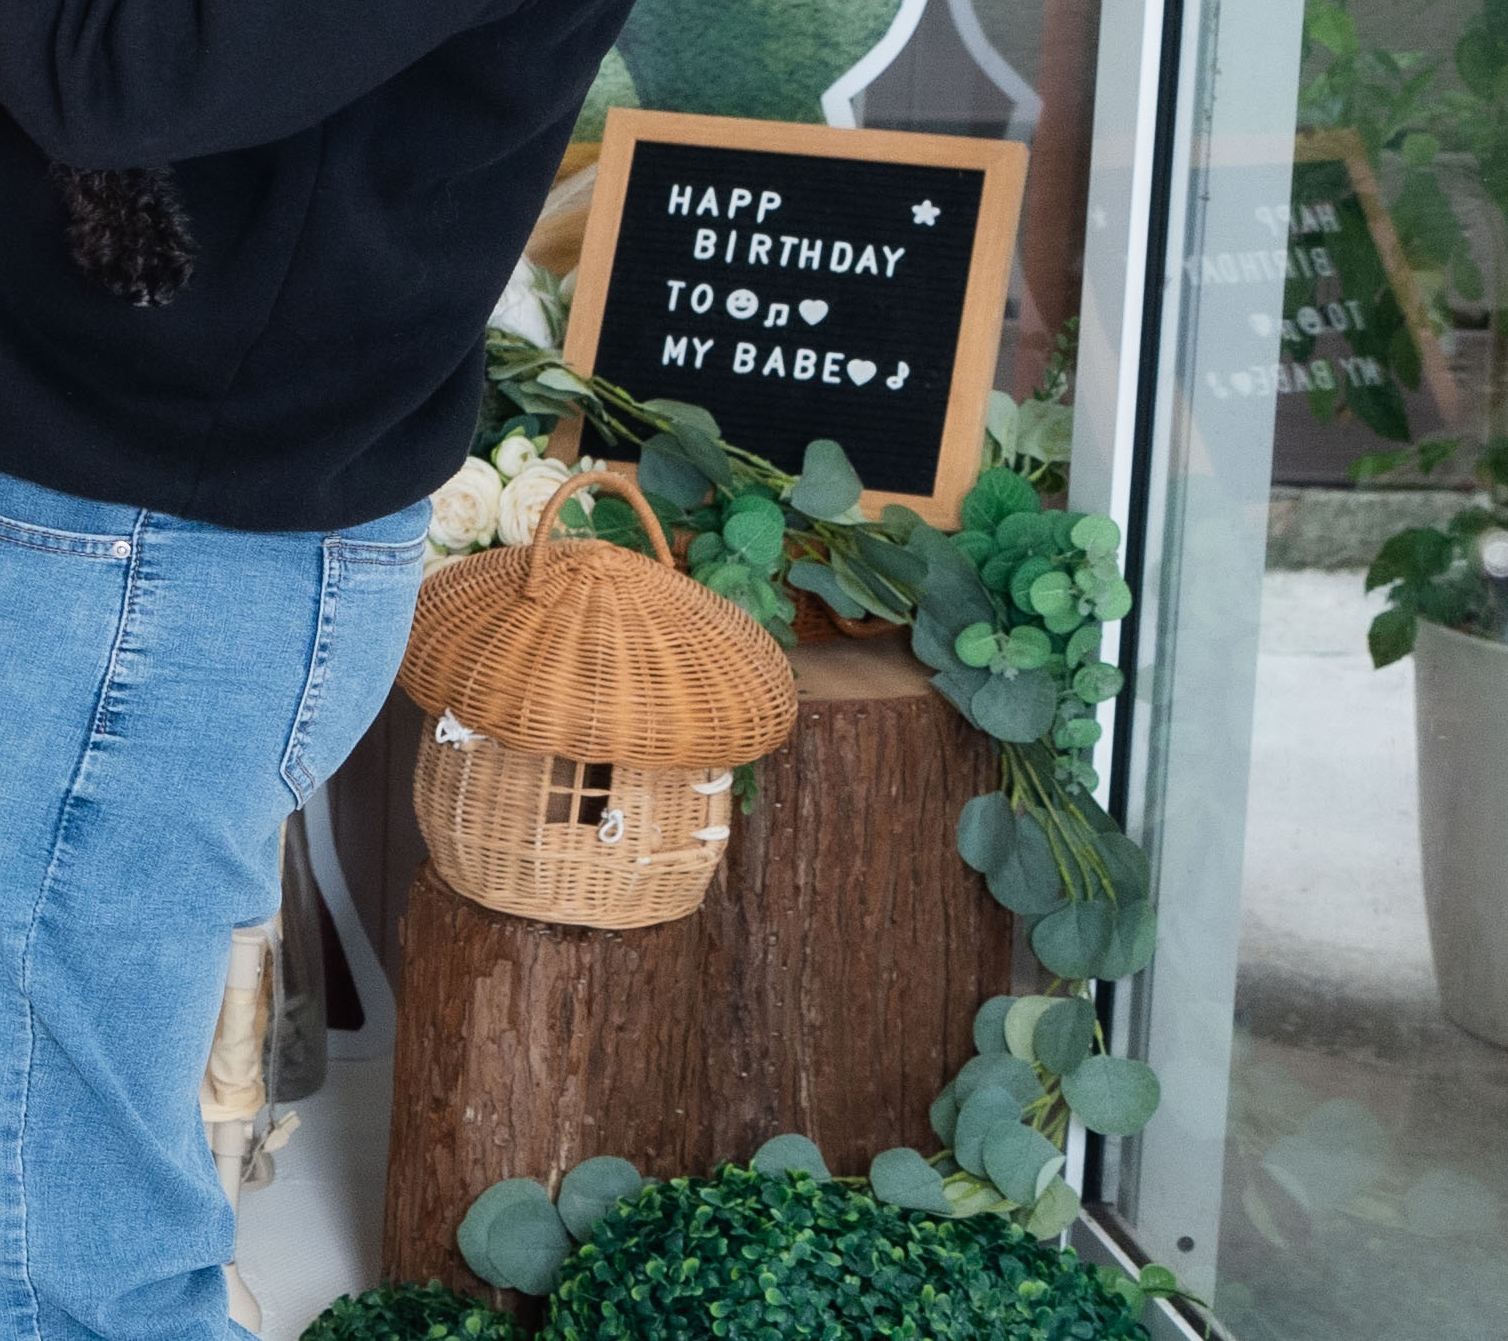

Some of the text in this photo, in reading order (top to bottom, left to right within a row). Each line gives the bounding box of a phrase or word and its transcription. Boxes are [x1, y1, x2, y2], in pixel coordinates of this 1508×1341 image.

[668, 183, 782, 223] HAPP
[693, 228, 905, 278] BIRTHDAY
[667, 280, 715, 314] TO
[661, 335, 842, 385] MY BABE
